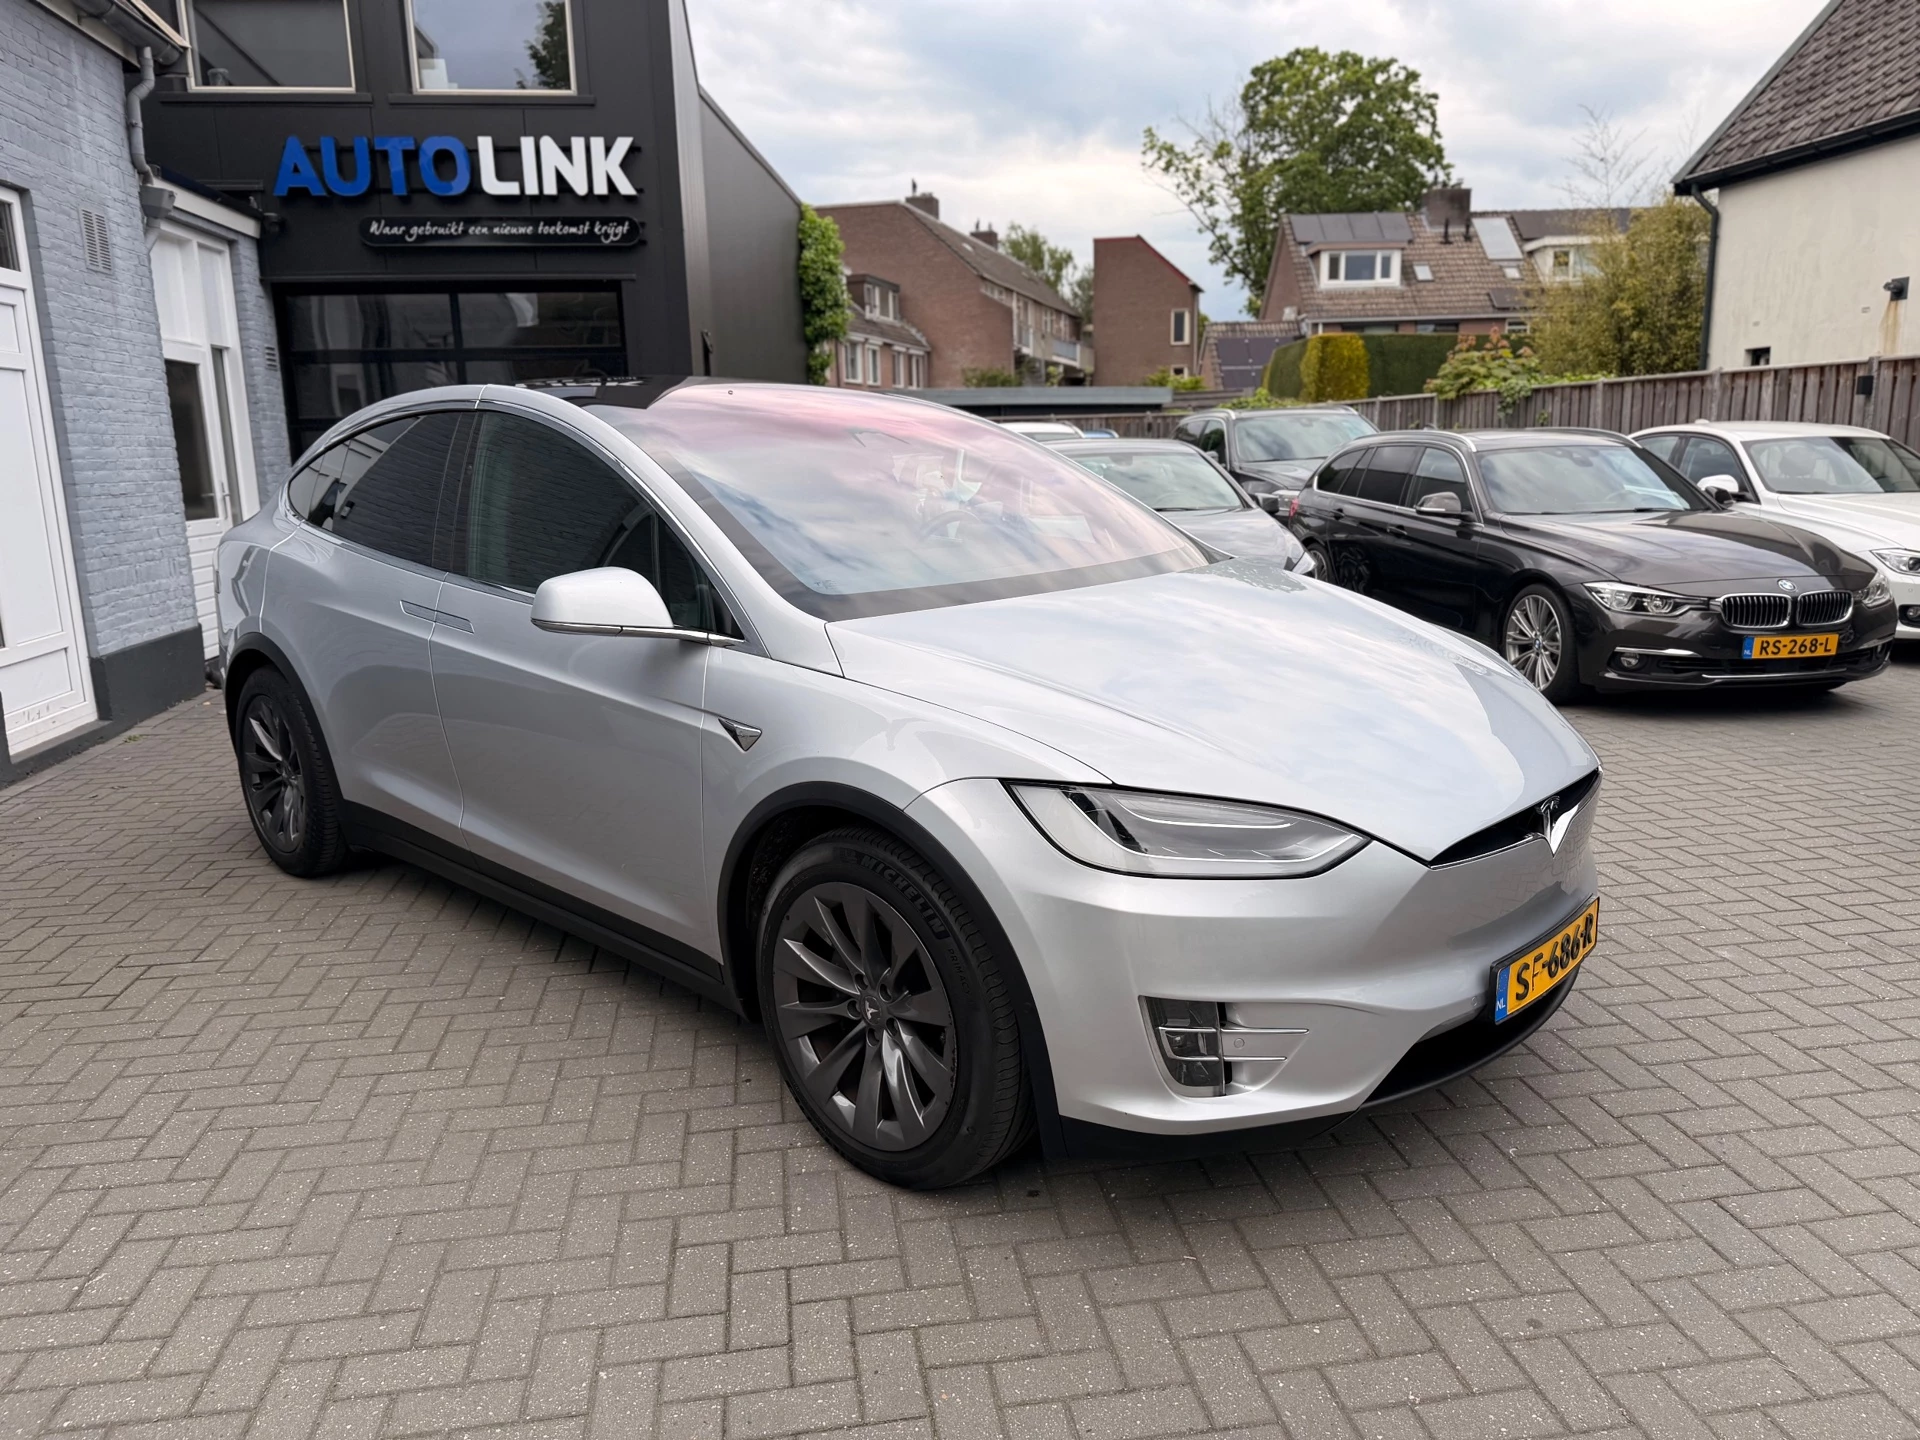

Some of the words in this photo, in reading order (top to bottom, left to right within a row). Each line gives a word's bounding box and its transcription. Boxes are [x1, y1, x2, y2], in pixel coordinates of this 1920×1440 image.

[273, 135, 638, 196] AUTOLINK
[369, 219, 406, 236] Waar
[405, 221, 464, 242] gebruikt
[468, 225, 489, 235] een
[492, 223, 533, 235] nieuwe
[538, 221, 590, 235] toekomst
[1759, 637, 1832, 656] RS-268-L
[860, 854, 946, 934] MICHELIN
[947, 947, 972, 996] PRIMACY
[1515, 912, 1594, 1002] SF-686-R
[1496, 997, 1506, 1011] NL
